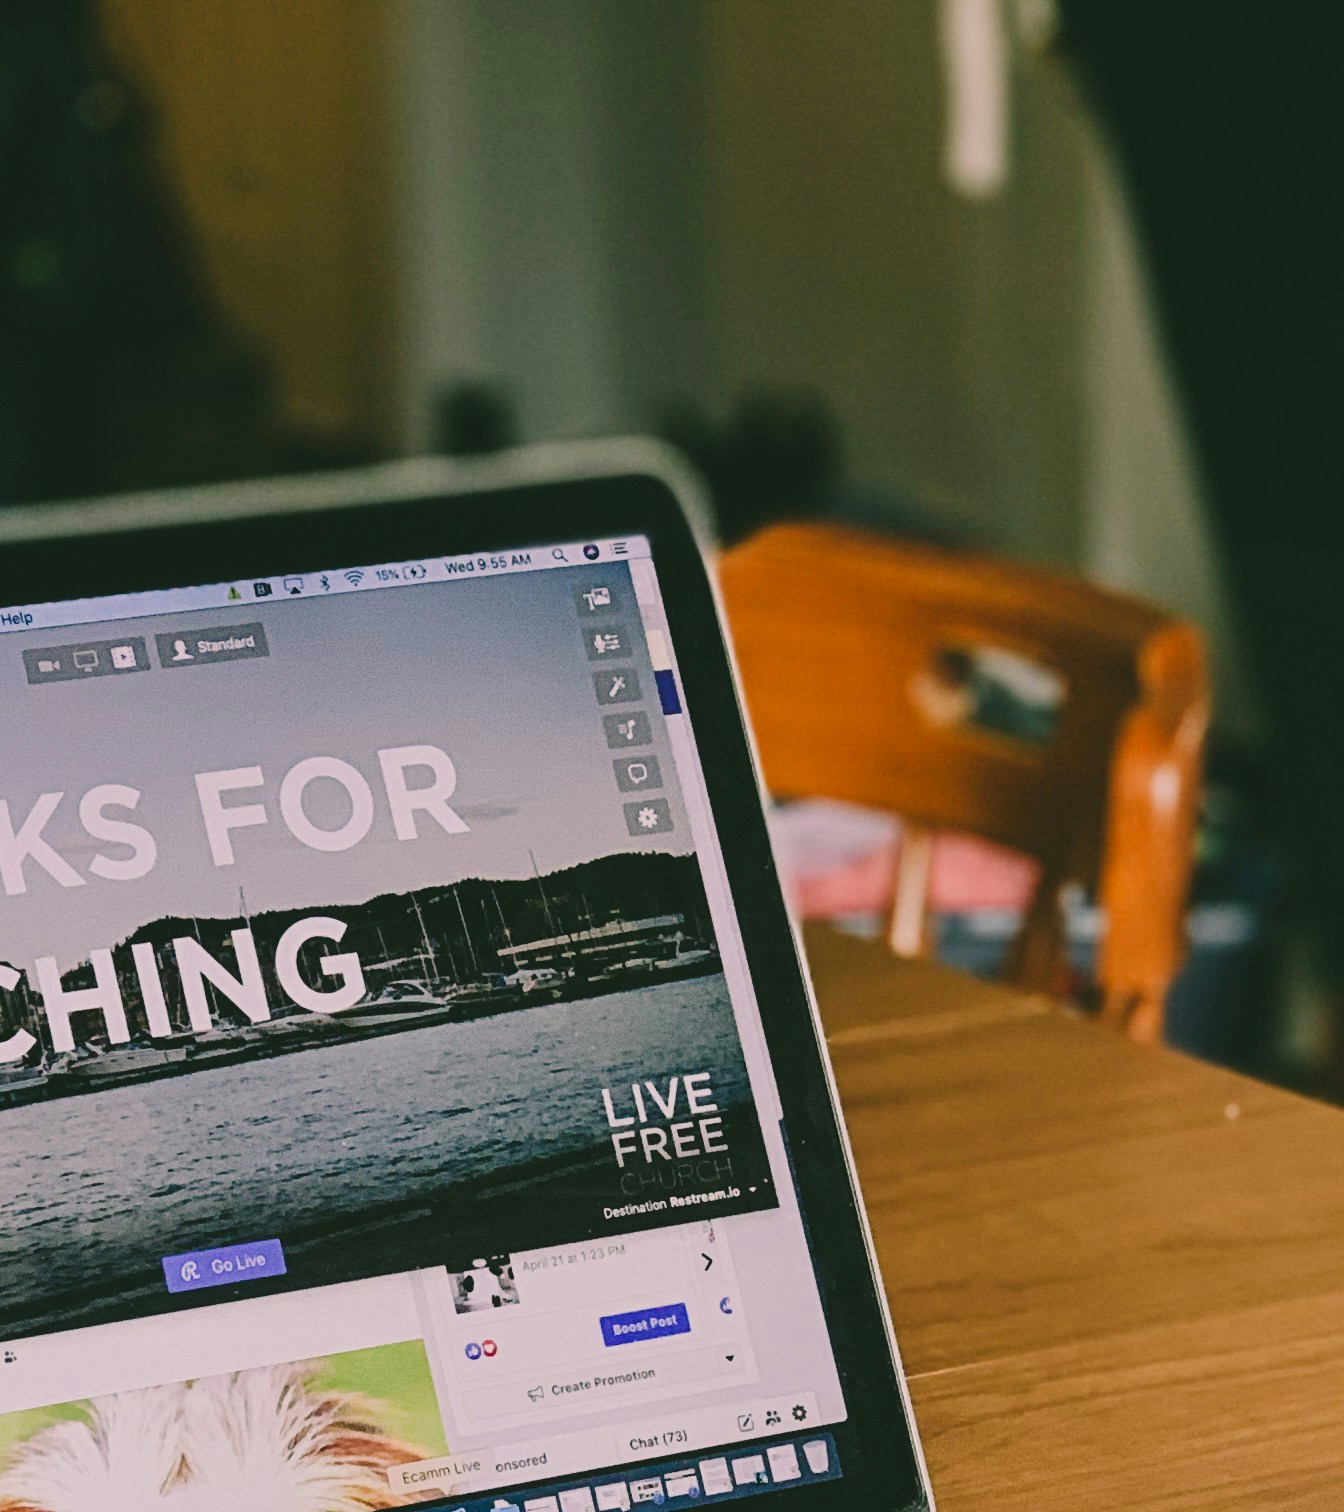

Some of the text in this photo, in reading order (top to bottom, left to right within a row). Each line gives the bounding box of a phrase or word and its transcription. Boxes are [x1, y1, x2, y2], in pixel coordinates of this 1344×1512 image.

[375, 568, 400, 582] 15%
[444, 561, 477, 575] Wed
[510, 552, 532, 567] AM
[1, 611, 33, 627] Help
[197, 635, 256, 654] Standard
[194, 743, 470, 867] FOR
[601, 1071, 718, 1128] LIVE
[611, 1116, 729, 1168] FREE
[620, 1157, 734, 1196] CHURCH
[603, 1186, 741, 1220] Destination Restream.io
[211, 1251, 267, 1275] Go Live
[522, 1256, 549, 1274] April
[567, 1250, 579, 1264] at
[608, 1243, 627, 1257] PM
[612, 1313, 678, 1337] Boost Post
[551, 1367, 656, 1397] Create Promotion
[629, 1428, 689, 1452] Chat (73)
[401, 1458, 482, 1486] Ecamm Live
